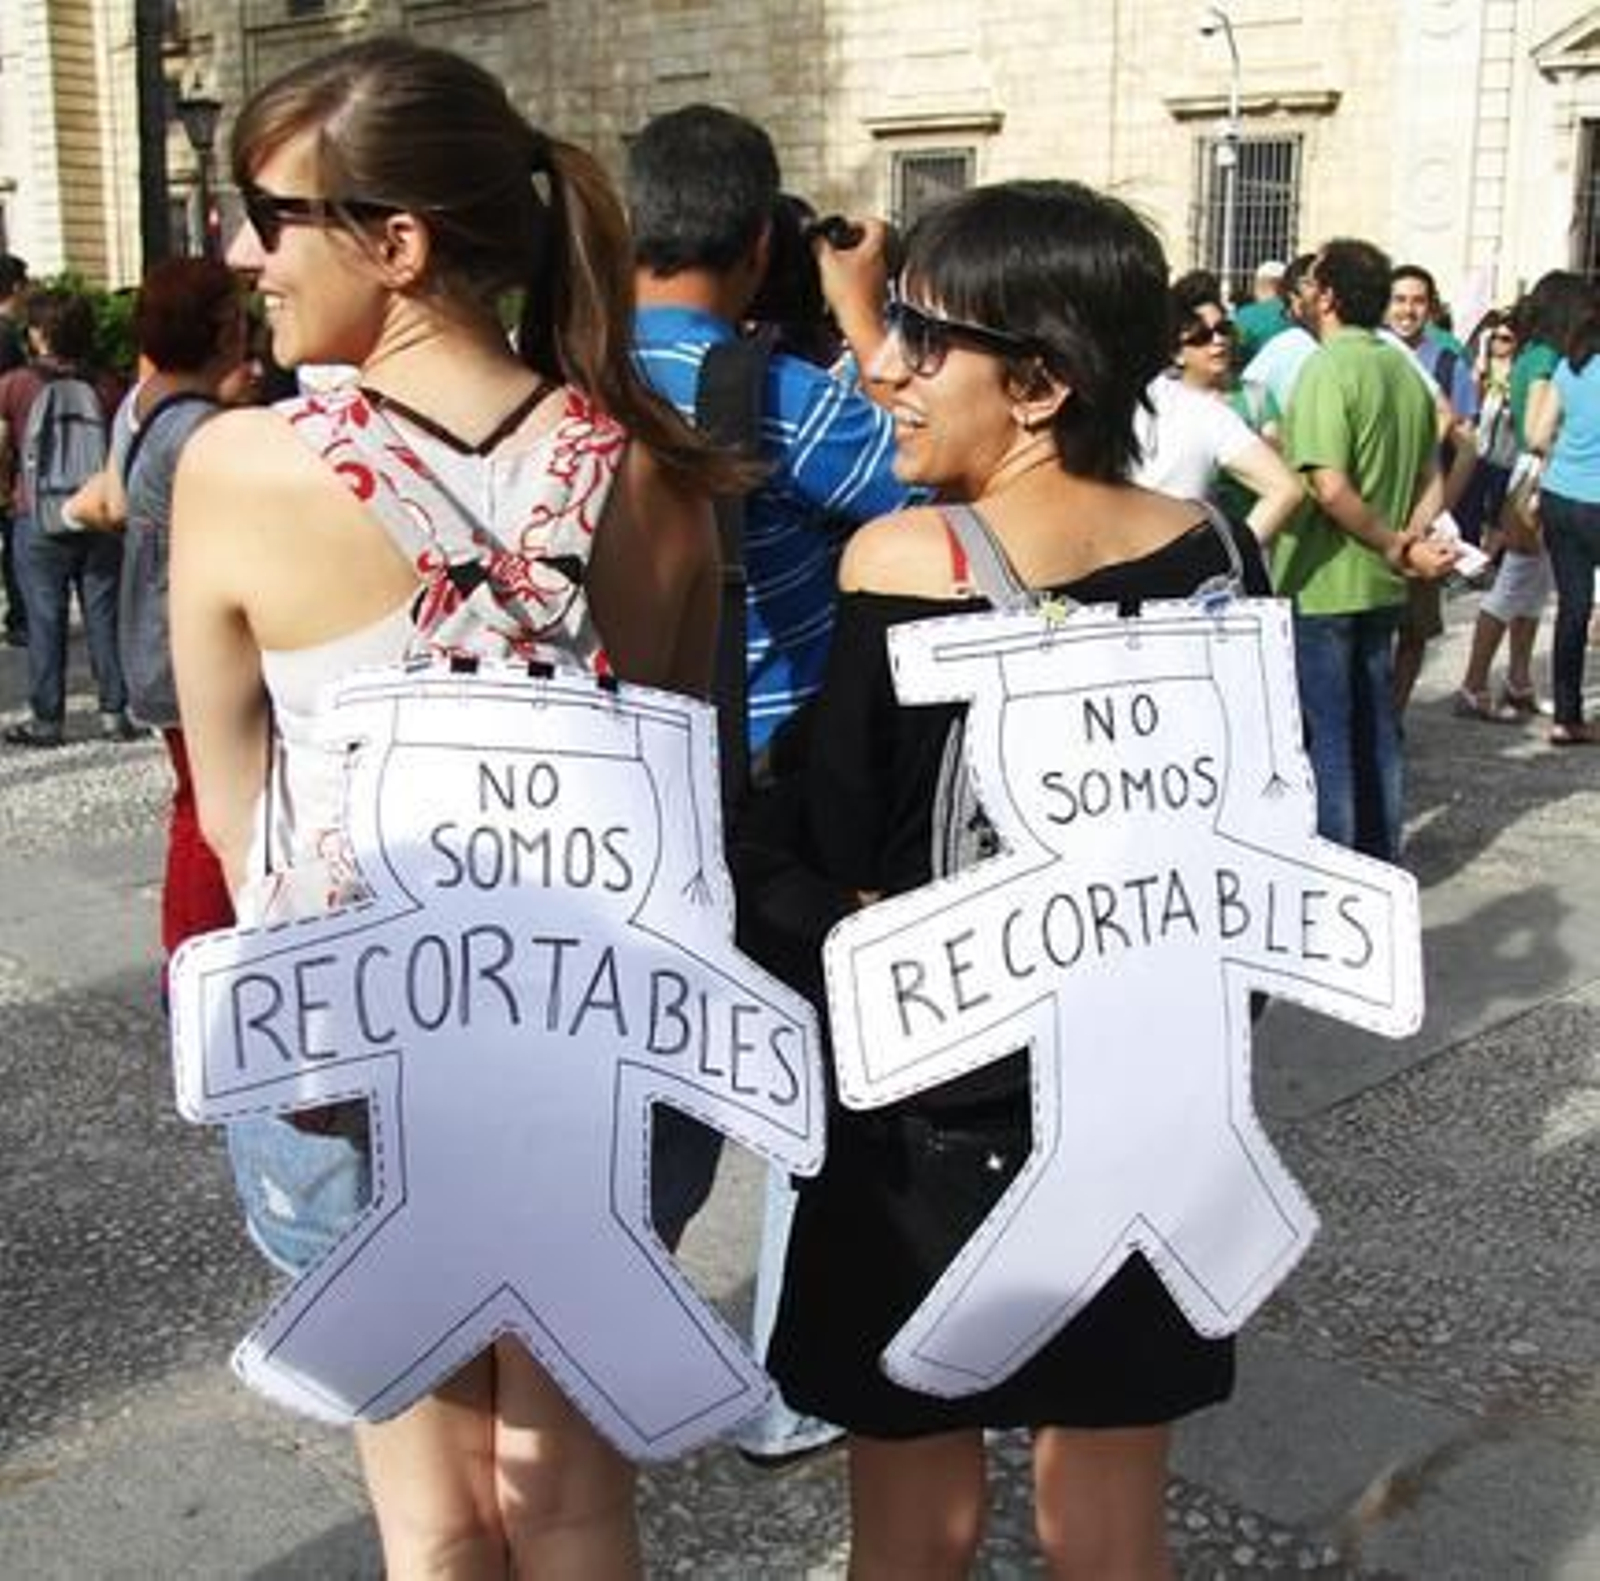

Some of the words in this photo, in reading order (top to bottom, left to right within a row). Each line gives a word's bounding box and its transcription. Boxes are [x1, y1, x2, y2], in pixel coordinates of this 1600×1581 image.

[1082, 693, 1160, 742] NO
[478, 762, 560, 812] NO
[1041, 756, 1219, 824] SOMOS
[429, 823, 634, 892] SOMOS
[890, 868, 1375, 1037] RECORTABLES
[230, 924, 801, 1107] RECORTABLES
